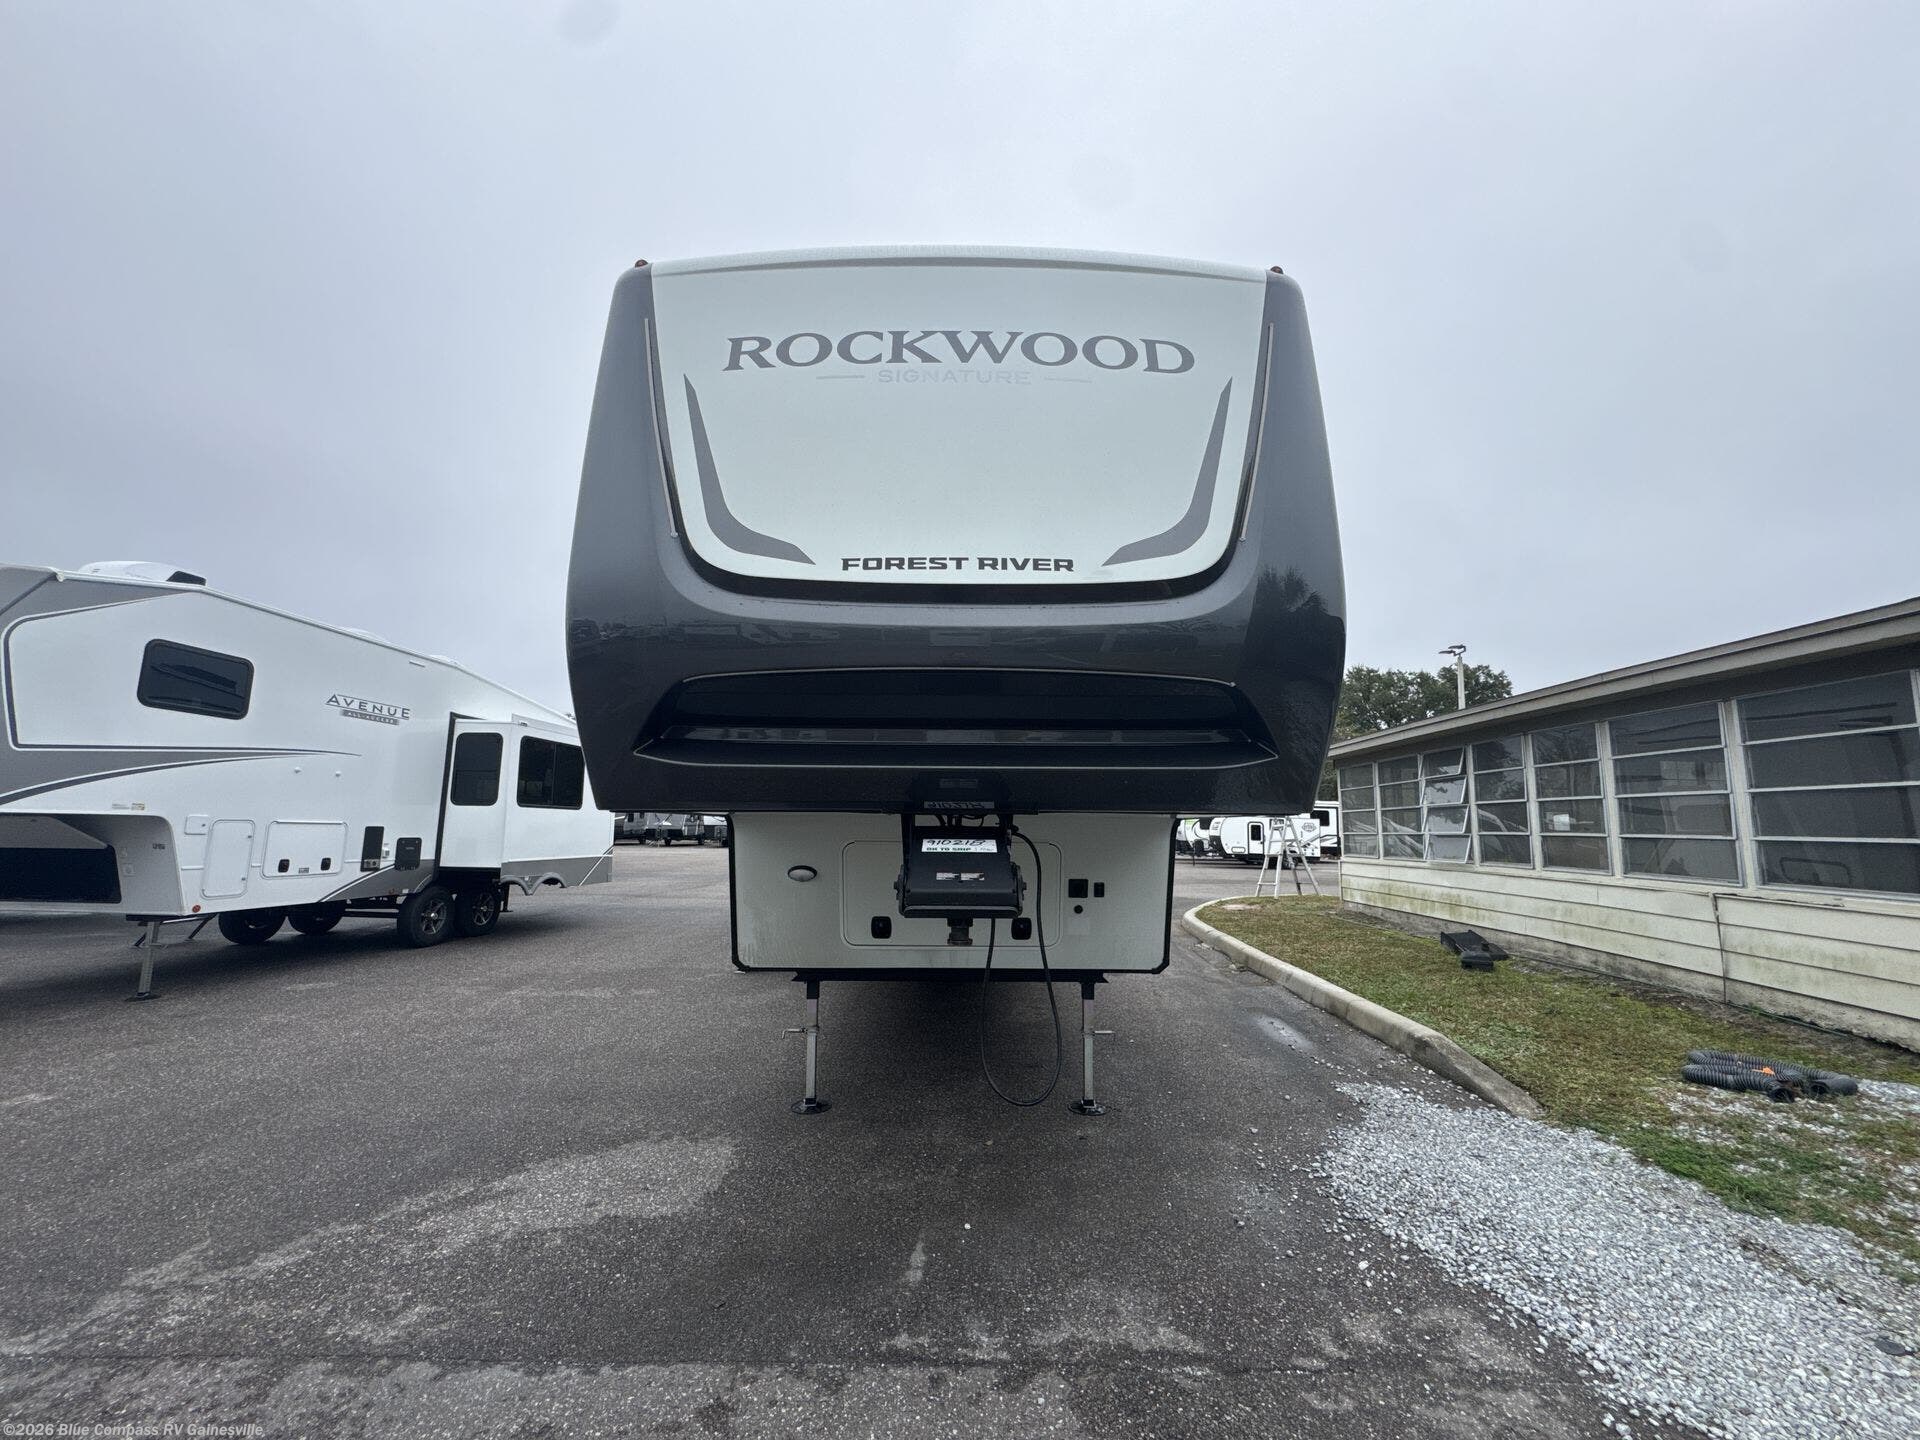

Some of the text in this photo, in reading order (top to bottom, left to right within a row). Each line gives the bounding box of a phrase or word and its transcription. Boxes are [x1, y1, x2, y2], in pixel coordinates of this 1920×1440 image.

[722, 330, 1195, 374] ROCKWOOD
[878, 369, 1032, 385] SIGNATURE
[841, 557, 1074, 572] FOREST RIVER
[326, 693, 411, 719] AVENUE
